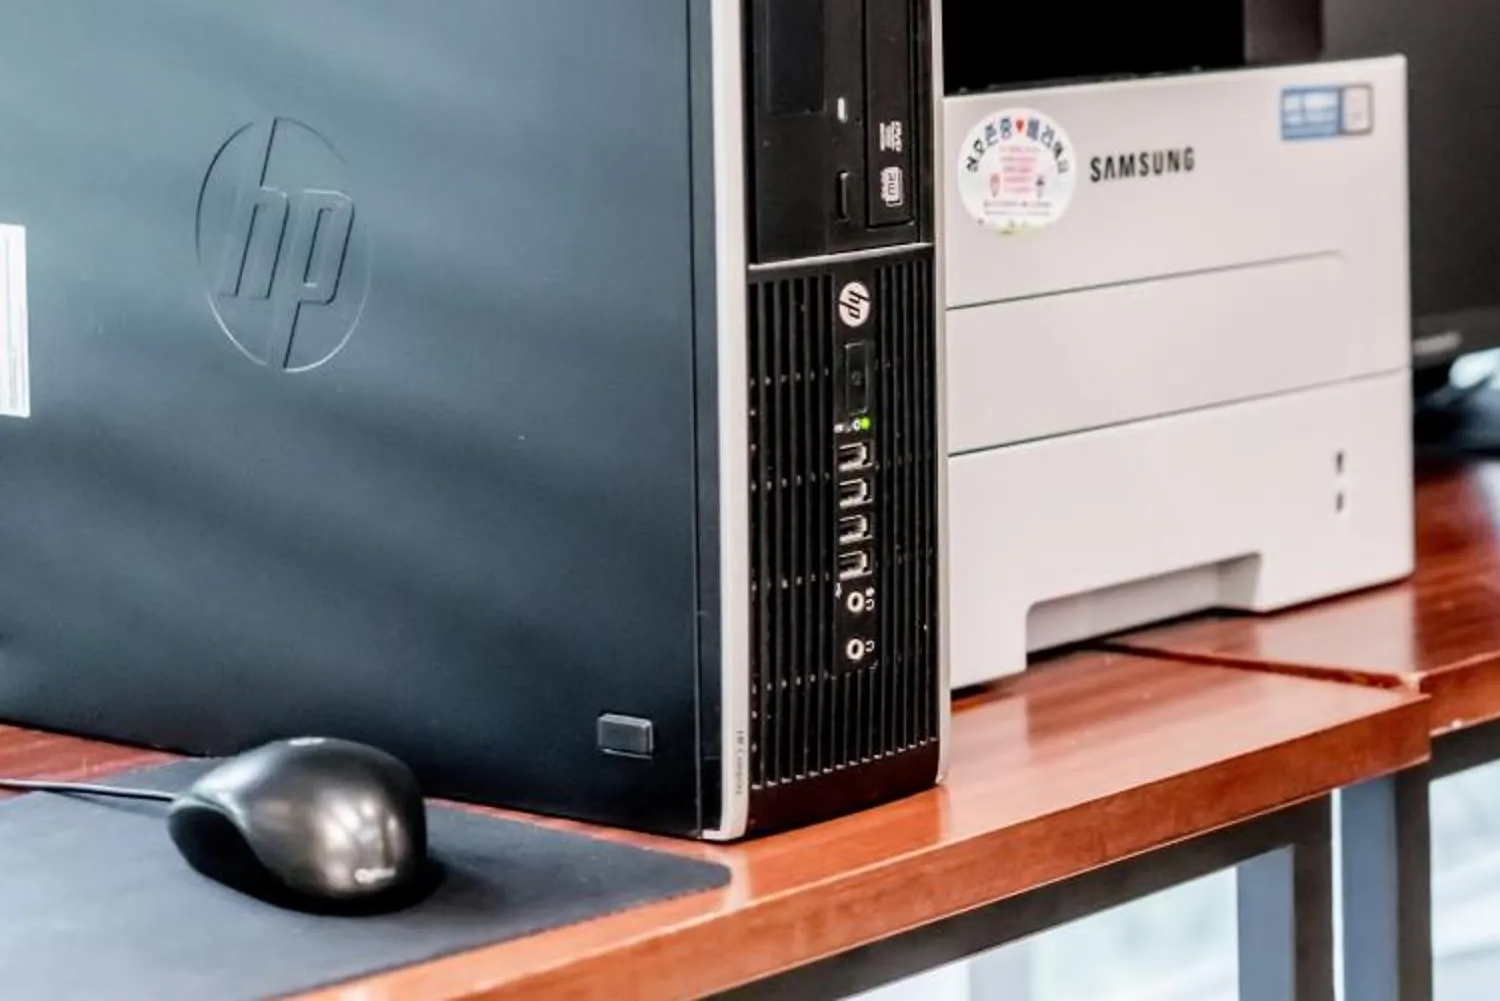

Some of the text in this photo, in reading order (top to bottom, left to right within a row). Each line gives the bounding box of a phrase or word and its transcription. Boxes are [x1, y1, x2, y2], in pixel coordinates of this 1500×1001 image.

[1089, 146, 1195, 183] SAMSUNG
[212, 117, 358, 371] hp
[839, 288, 871, 321] hp
